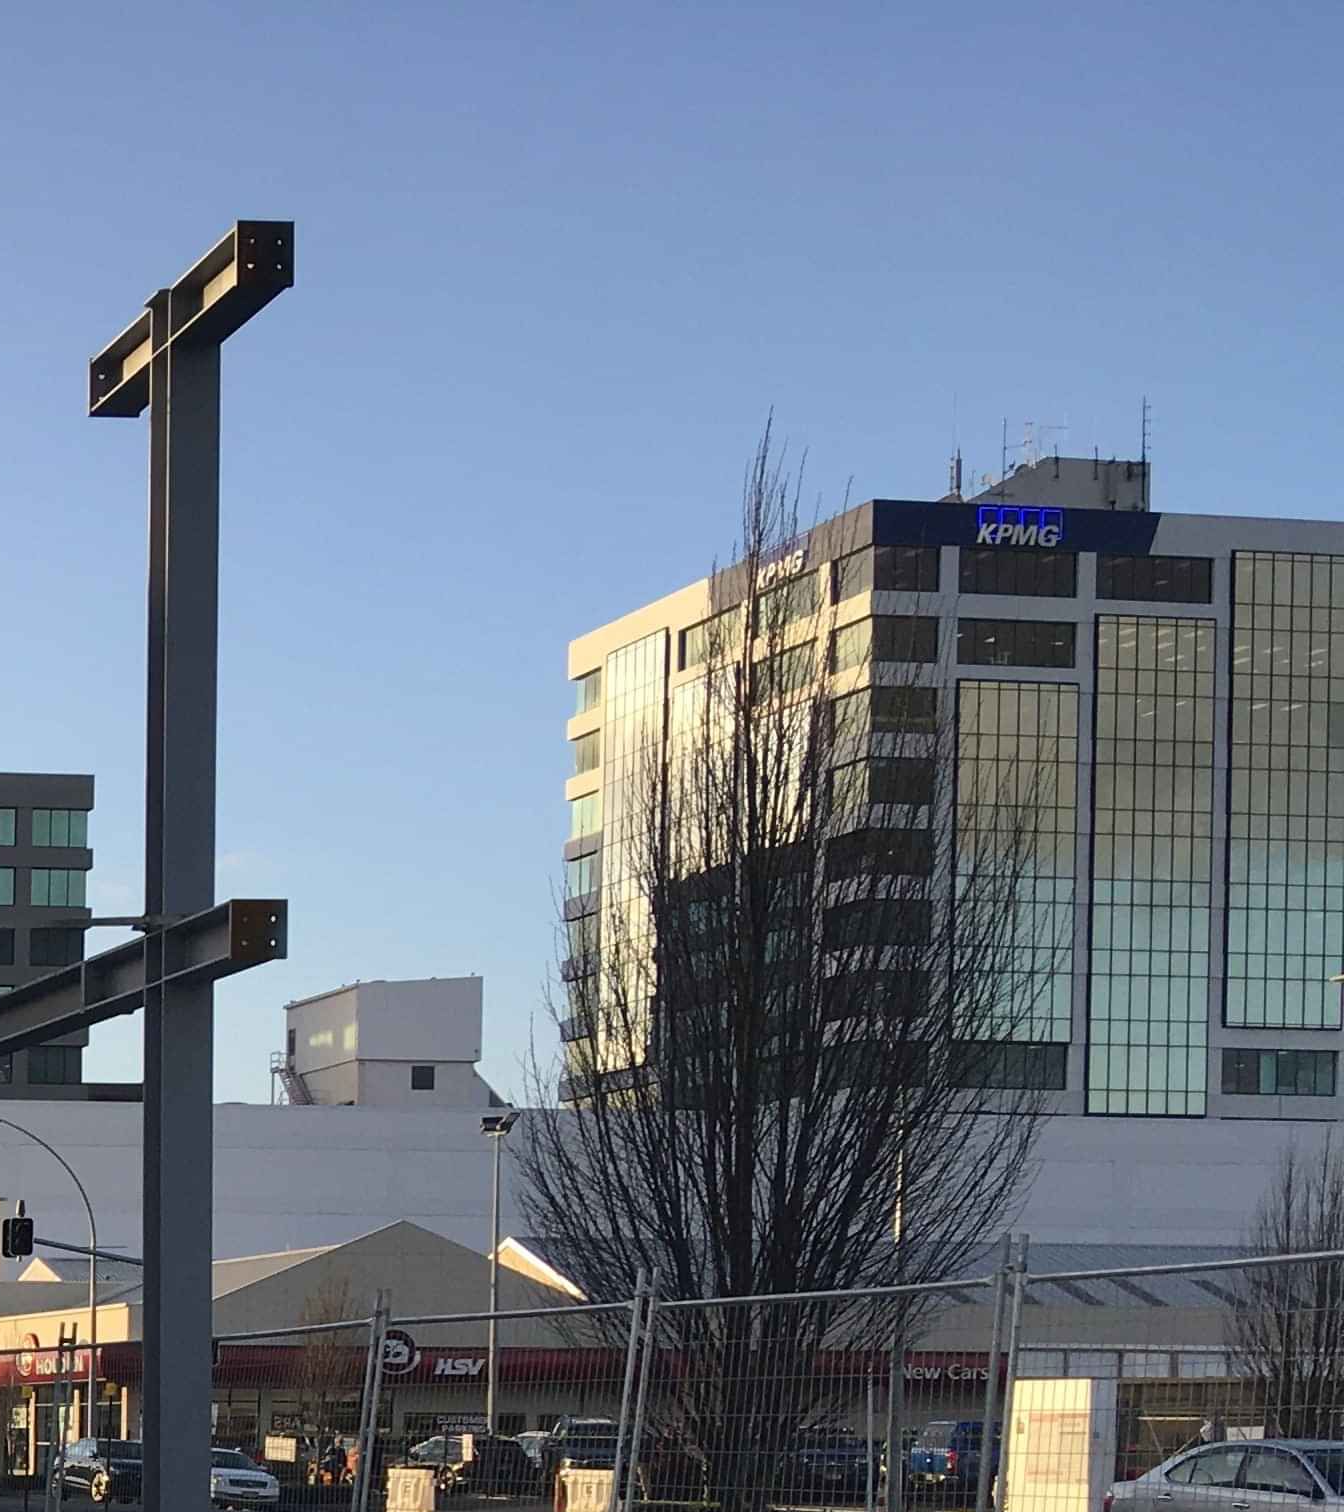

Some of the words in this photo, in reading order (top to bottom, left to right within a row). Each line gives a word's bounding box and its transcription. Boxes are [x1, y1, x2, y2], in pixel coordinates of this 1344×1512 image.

[977, 523, 1060, 547] KPMG
[434, 1358, 486, 1375] HSV
[904, 1363, 941, 1380] New
[947, 1363, 990, 1380] Cars
